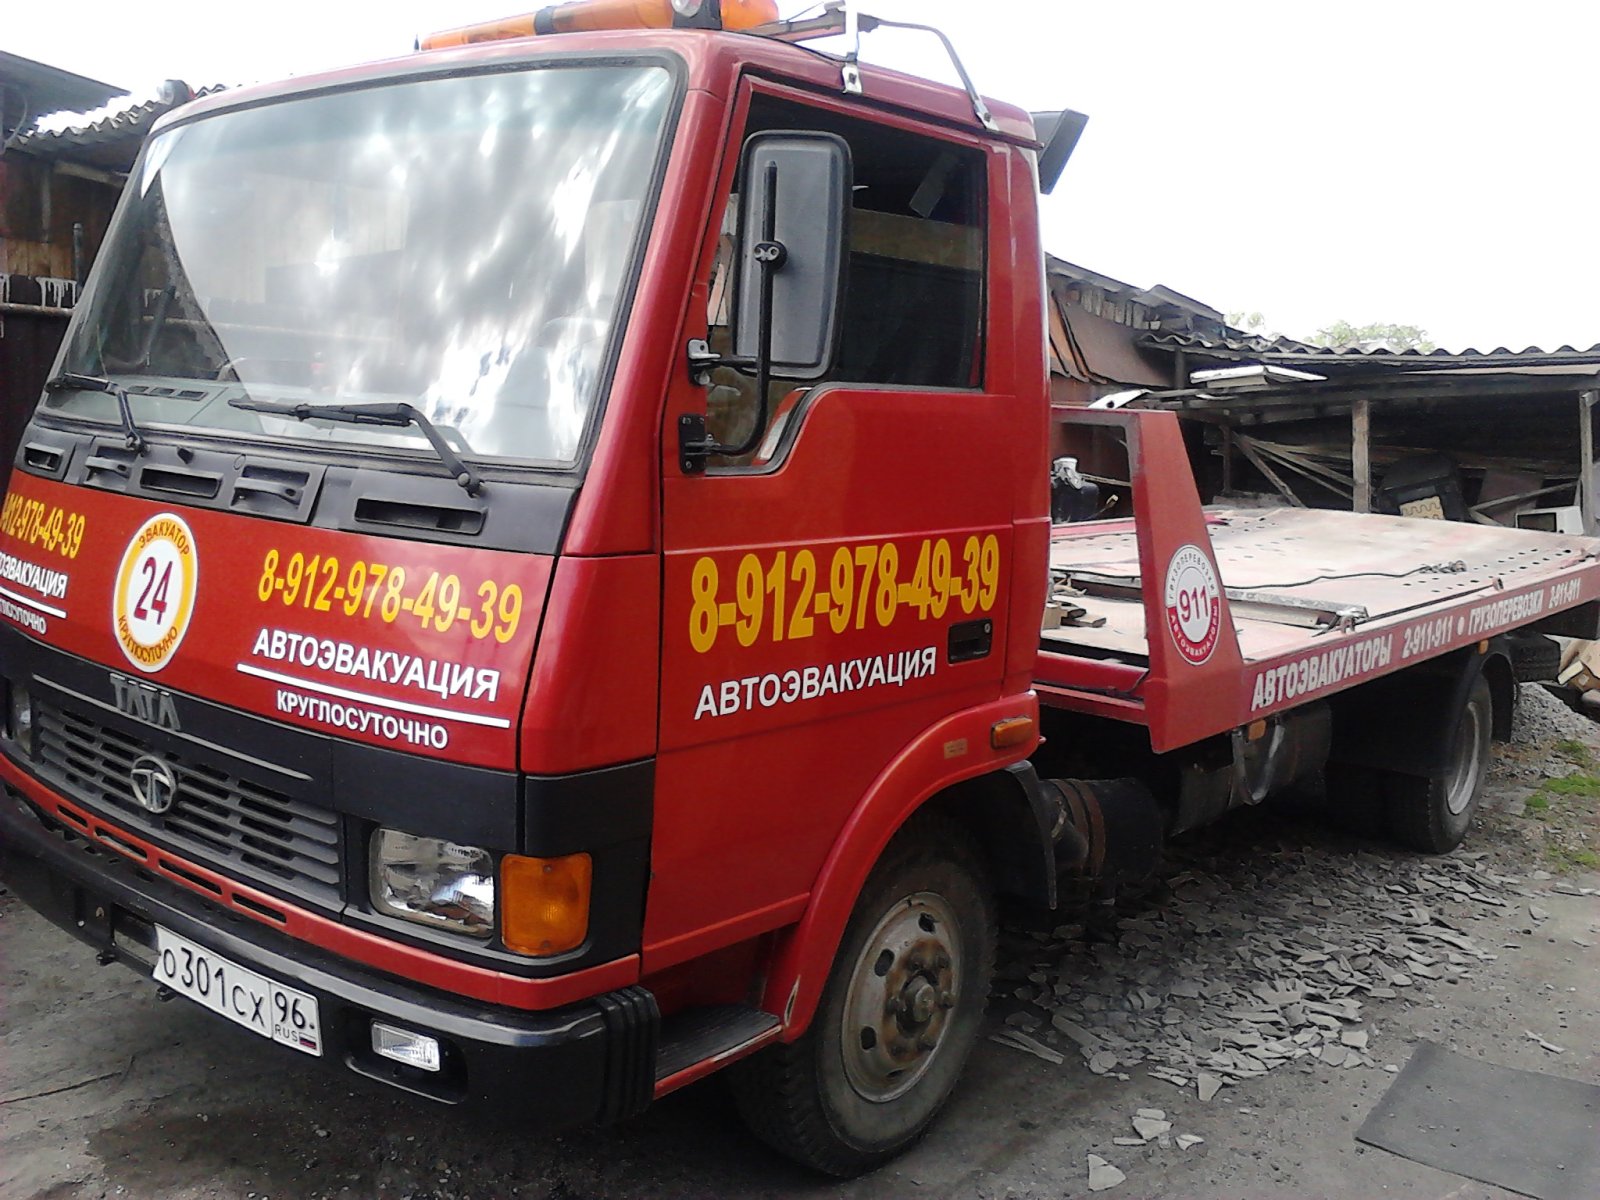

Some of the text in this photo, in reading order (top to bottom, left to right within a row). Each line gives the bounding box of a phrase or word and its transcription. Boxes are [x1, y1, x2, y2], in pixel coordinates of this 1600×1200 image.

[138, 521, 190, 556] ЭВАКУАТОР
[134, 556, 173, 625] 24
[258, 549, 523, 643] 8-912-978-49-39
[689, 534, 999, 653] 8-912-978-49-39
[1180, 586, 1209, 623] 911
[117, 614, 178, 664] КРУГЛОСУТОЧНО
[253, 628, 499, 702] АВТОЭВАКУАЦИЯ
[1251, 634, 1393, 711] АВТОЭВАКУАТОРЫ
[1402, 615, 1454, 659] 2-911-911
[1468, 589, 1544, 636] ГРУЗОПЕРЕВОЗКИ
[110, 673, 181, 730] TATA
[694, 647, 937, 720] АВТОЭВАКУАЦИЯ
[276, 689, 448, 750] КРУГЛОСУТОЧНО
[274, 1024, 299, 1042] RUS
[275, 991, 306, 1030] 96
